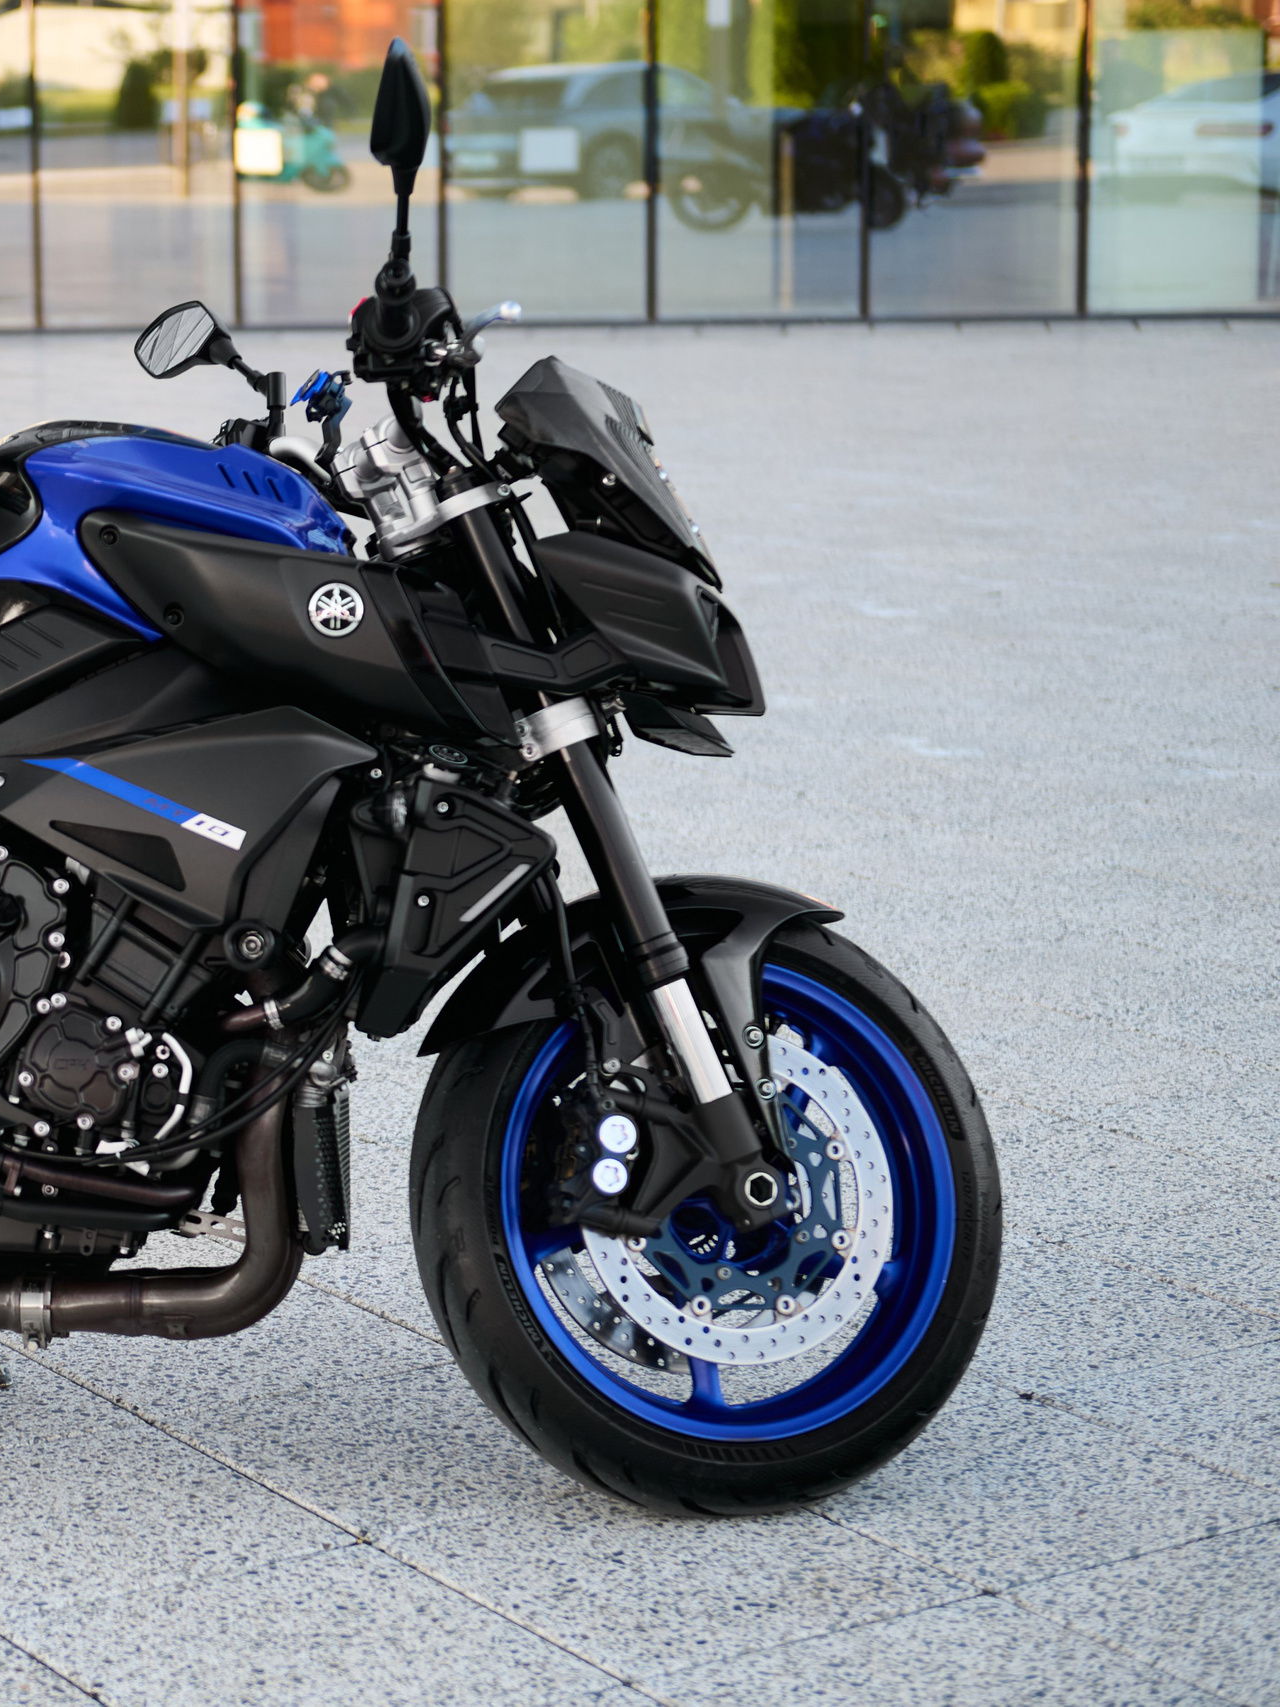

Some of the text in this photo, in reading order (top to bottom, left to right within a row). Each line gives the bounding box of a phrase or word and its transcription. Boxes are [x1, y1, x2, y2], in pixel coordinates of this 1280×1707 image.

[144, 797, 230, 837] MT 10
[916, 1055, 961, 1133] MICHELIN
[497, 1261, 540, 1342] MICHELIN
